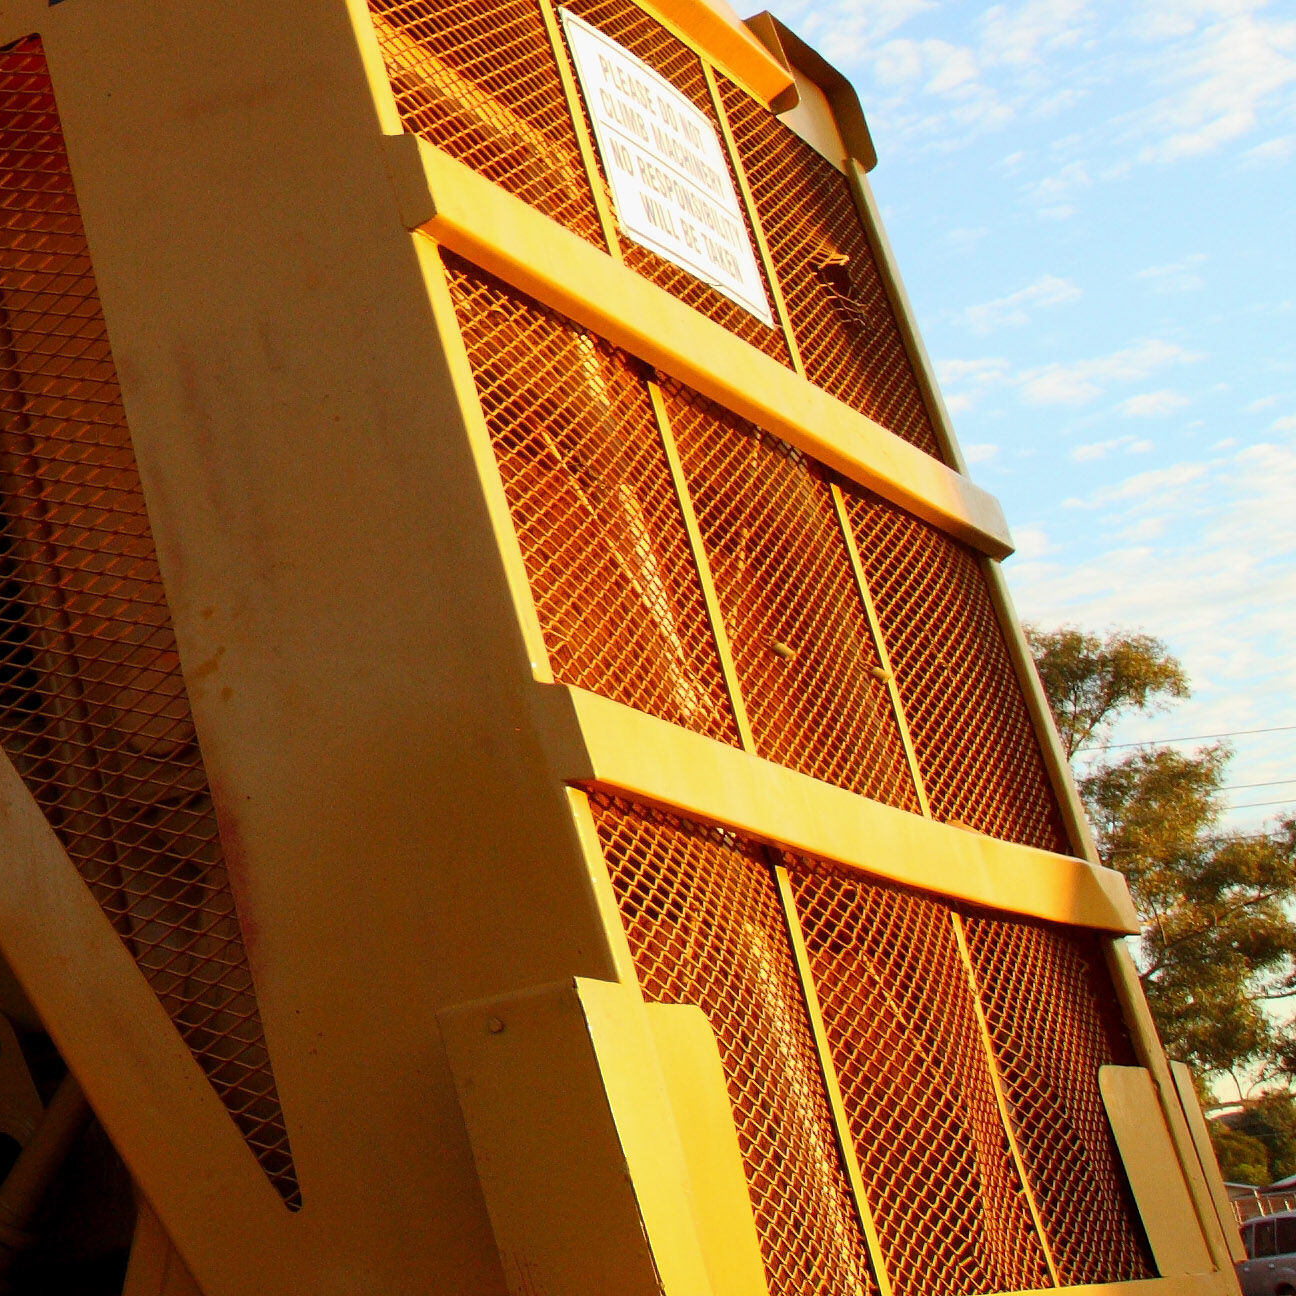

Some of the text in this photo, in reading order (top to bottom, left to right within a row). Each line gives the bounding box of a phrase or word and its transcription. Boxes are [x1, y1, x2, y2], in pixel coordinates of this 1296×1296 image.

[599, 54, 706, 156] PLEASE DO NOT
[600, 88, 727, 201] CLIMB MACHINERY
[609, 138, 743, 254] NO RESPONSIBILITY
[640, 192, 744, 284] WILL BE TAKEN
